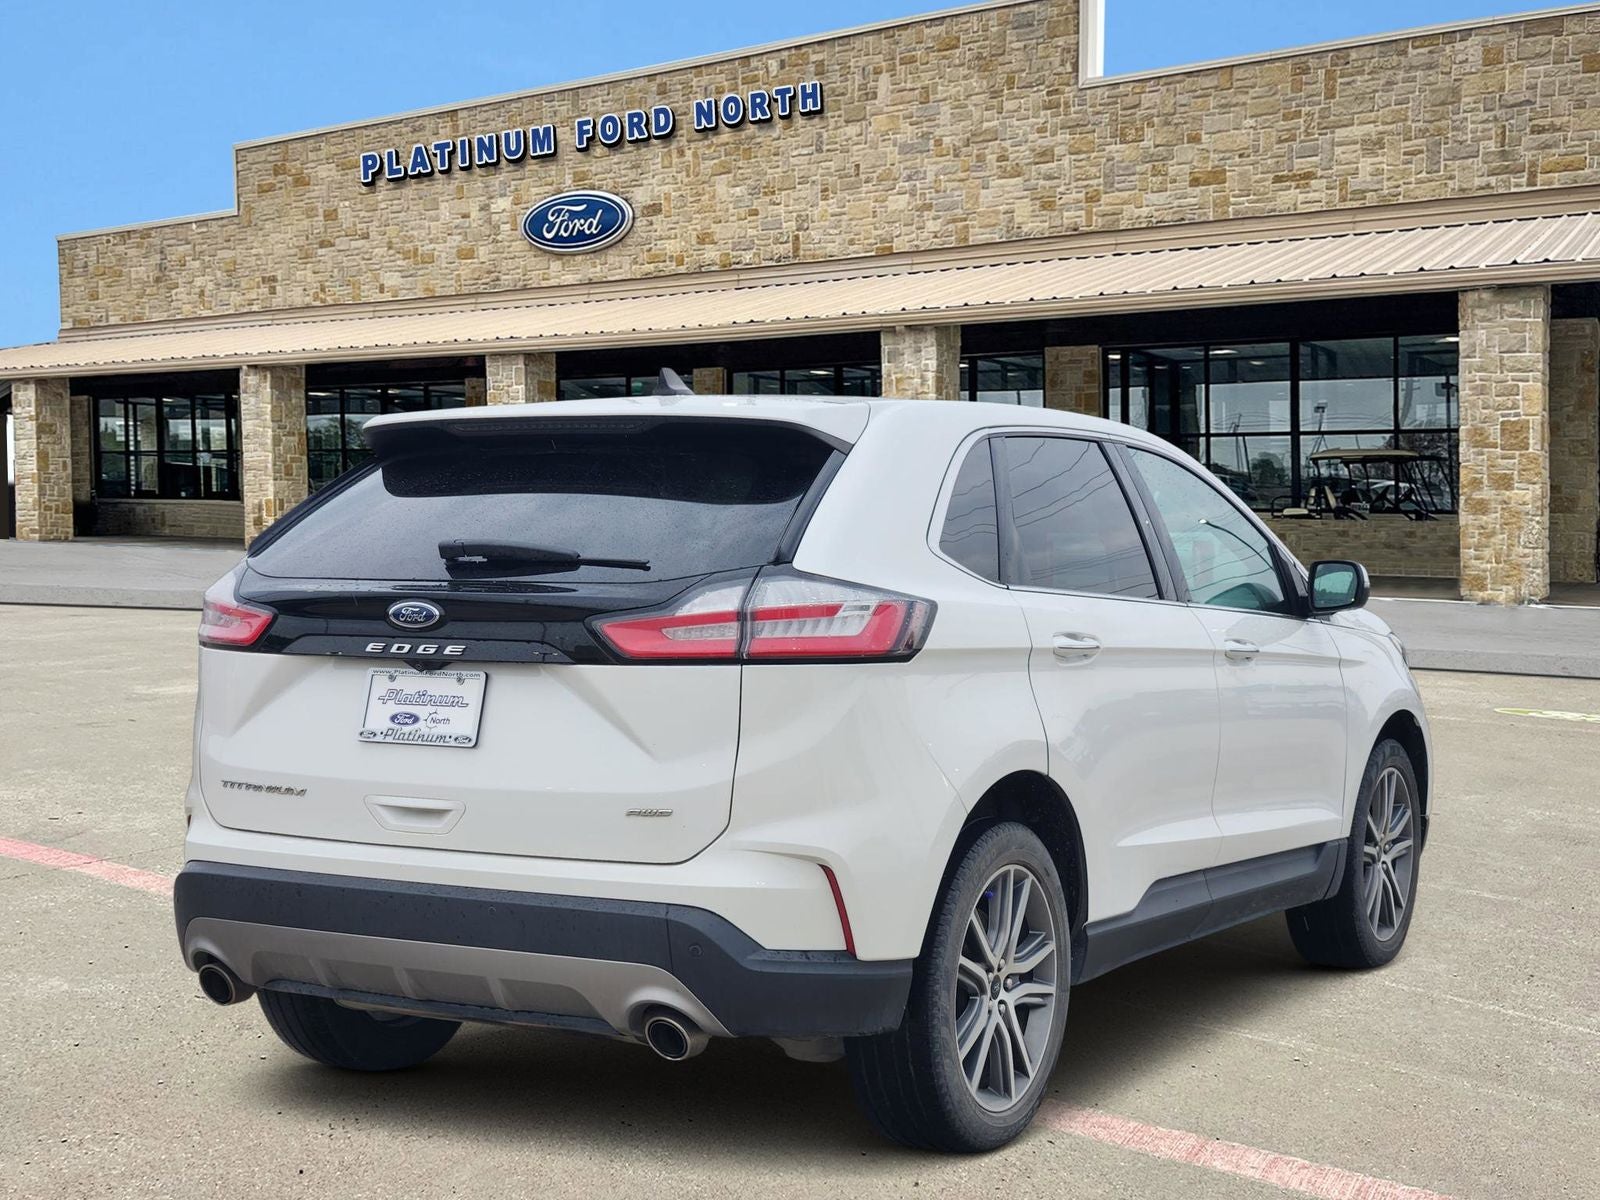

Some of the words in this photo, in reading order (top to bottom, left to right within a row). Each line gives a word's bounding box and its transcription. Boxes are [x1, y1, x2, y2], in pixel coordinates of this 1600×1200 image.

[360, 124, 557, 186] PLATINUM
[575, 104, 675, 151] FORD
[694, 81, 823, 132] NORTH
[542, 203, 603, 239] Ford
[399, 606, 426, 622] Ford
[365, 642, 467, 656] EDGE
[378, 688, 469, 708] Platinum
[394, 713, 415, 725] Ford
[429, 716, 451, 726] North
[383, 727, 450, 744] Platinum
